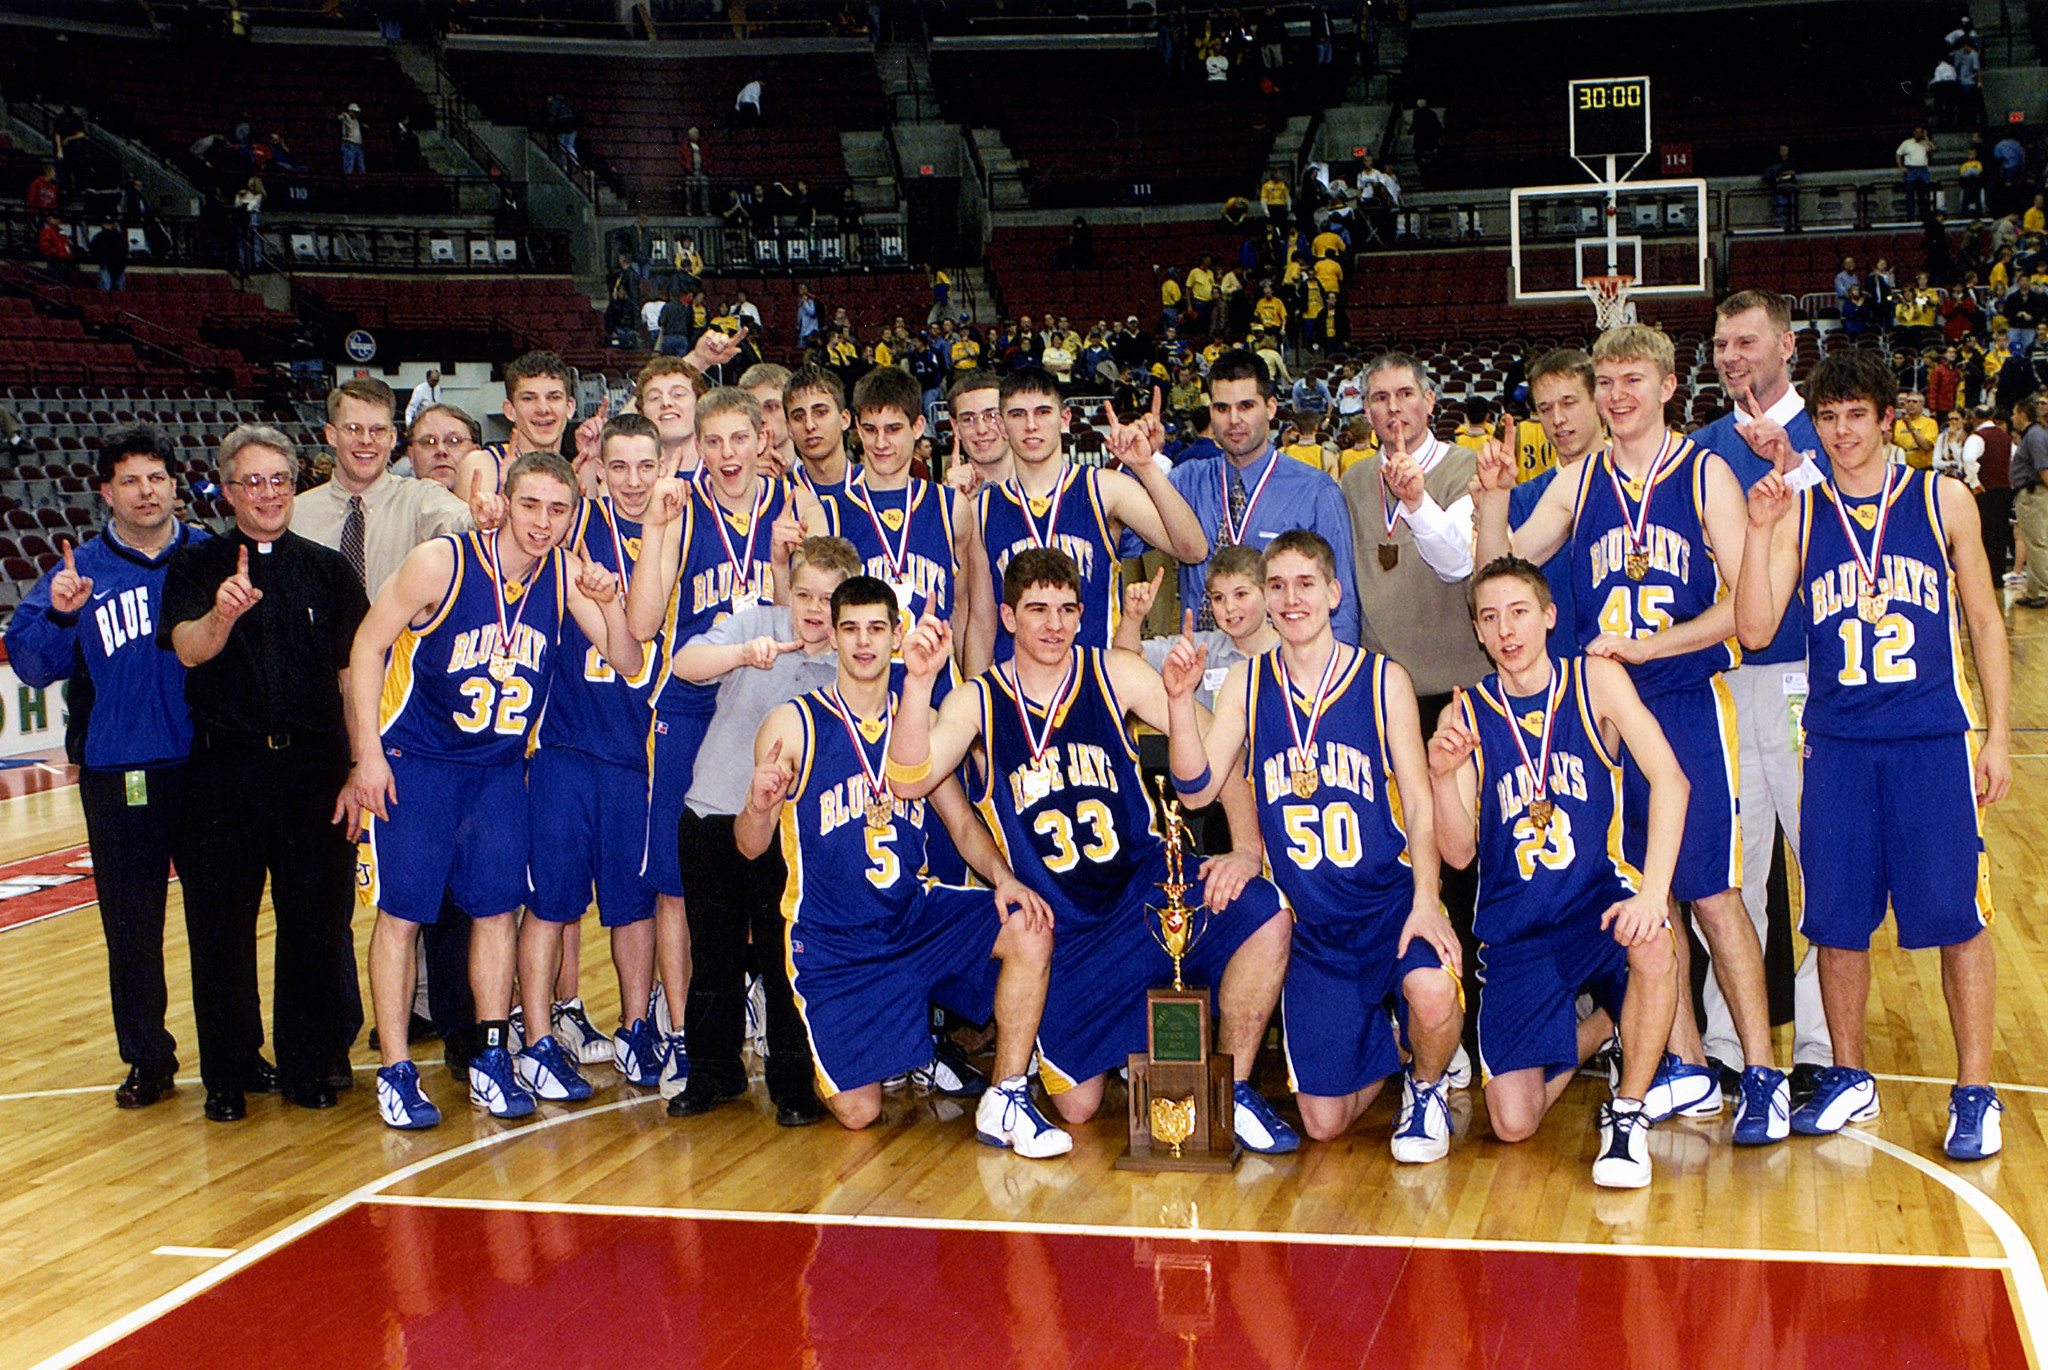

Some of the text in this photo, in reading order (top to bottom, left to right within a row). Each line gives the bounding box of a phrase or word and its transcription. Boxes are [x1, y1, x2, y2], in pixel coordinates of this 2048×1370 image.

[1579, 85, 1641, 110] 30:00
[1666, 153, 1687, 166] 114
[289, 186, 308, 200] 110
[1640, 523, 1691, 585] JAYS
[1878, 553, 1941, 615] JAYS
[94, 585, 153, 658] BLUE
[1597, 584, 1675, 641] 45
[1838, 611, 1918, 687] 12
[452, 675, 534, 736] 32
[1320, 740, 1375, 803] JAYS
[863, 823, 901, 890] 5
[1033, 798, 1121, 874] 33
[1282, 801, 1363, 871] 50
[1512, 803, 1577, 881] 23
